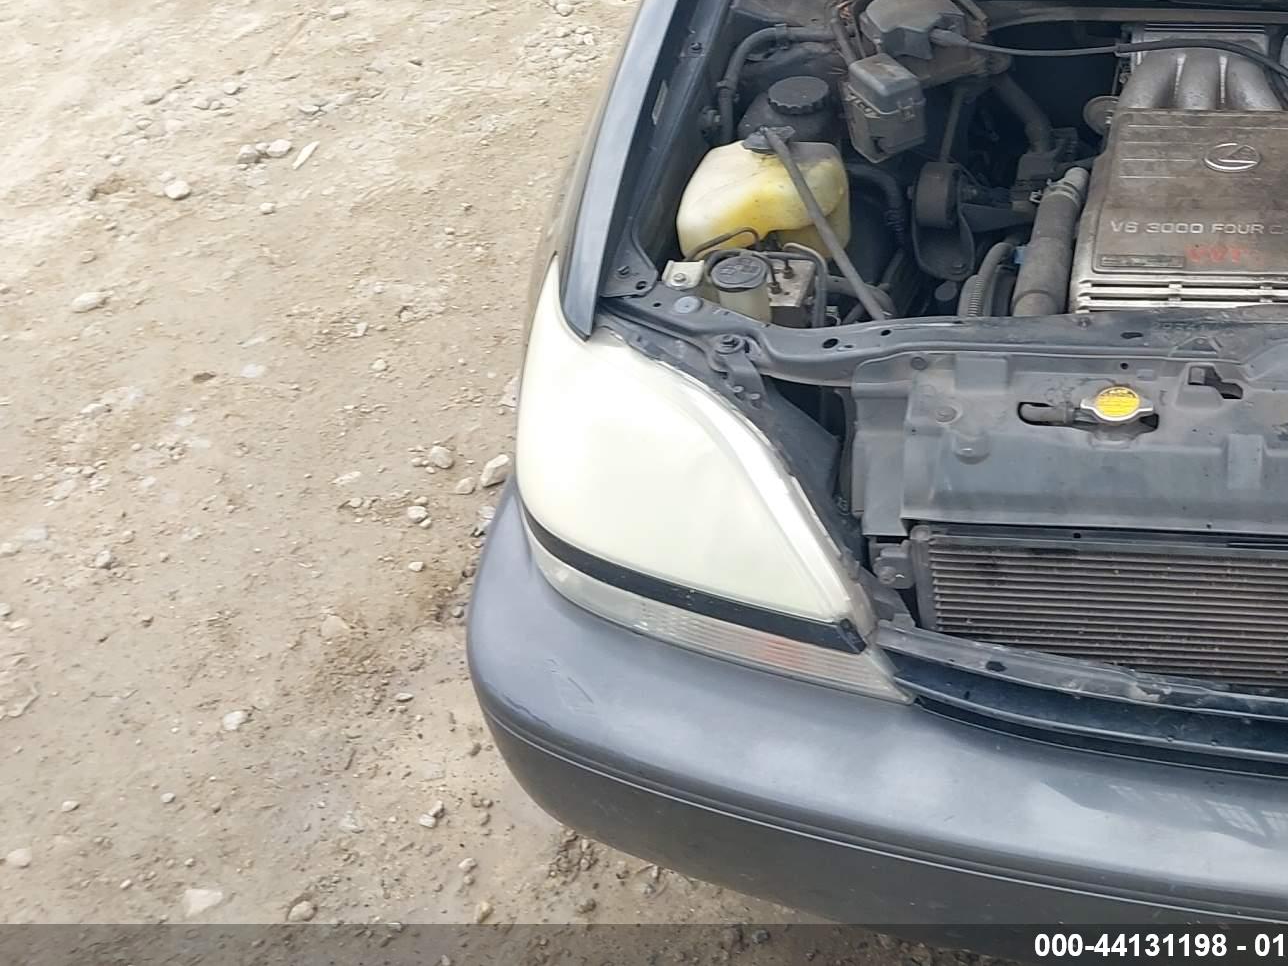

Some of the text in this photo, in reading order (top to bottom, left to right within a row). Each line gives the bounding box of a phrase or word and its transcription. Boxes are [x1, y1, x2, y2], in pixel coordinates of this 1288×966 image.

[1110, 220, 1138, 234] V6
[1145, 221, 1204, 234] 3000
[1210, 224, 1265, 235] FOUR
